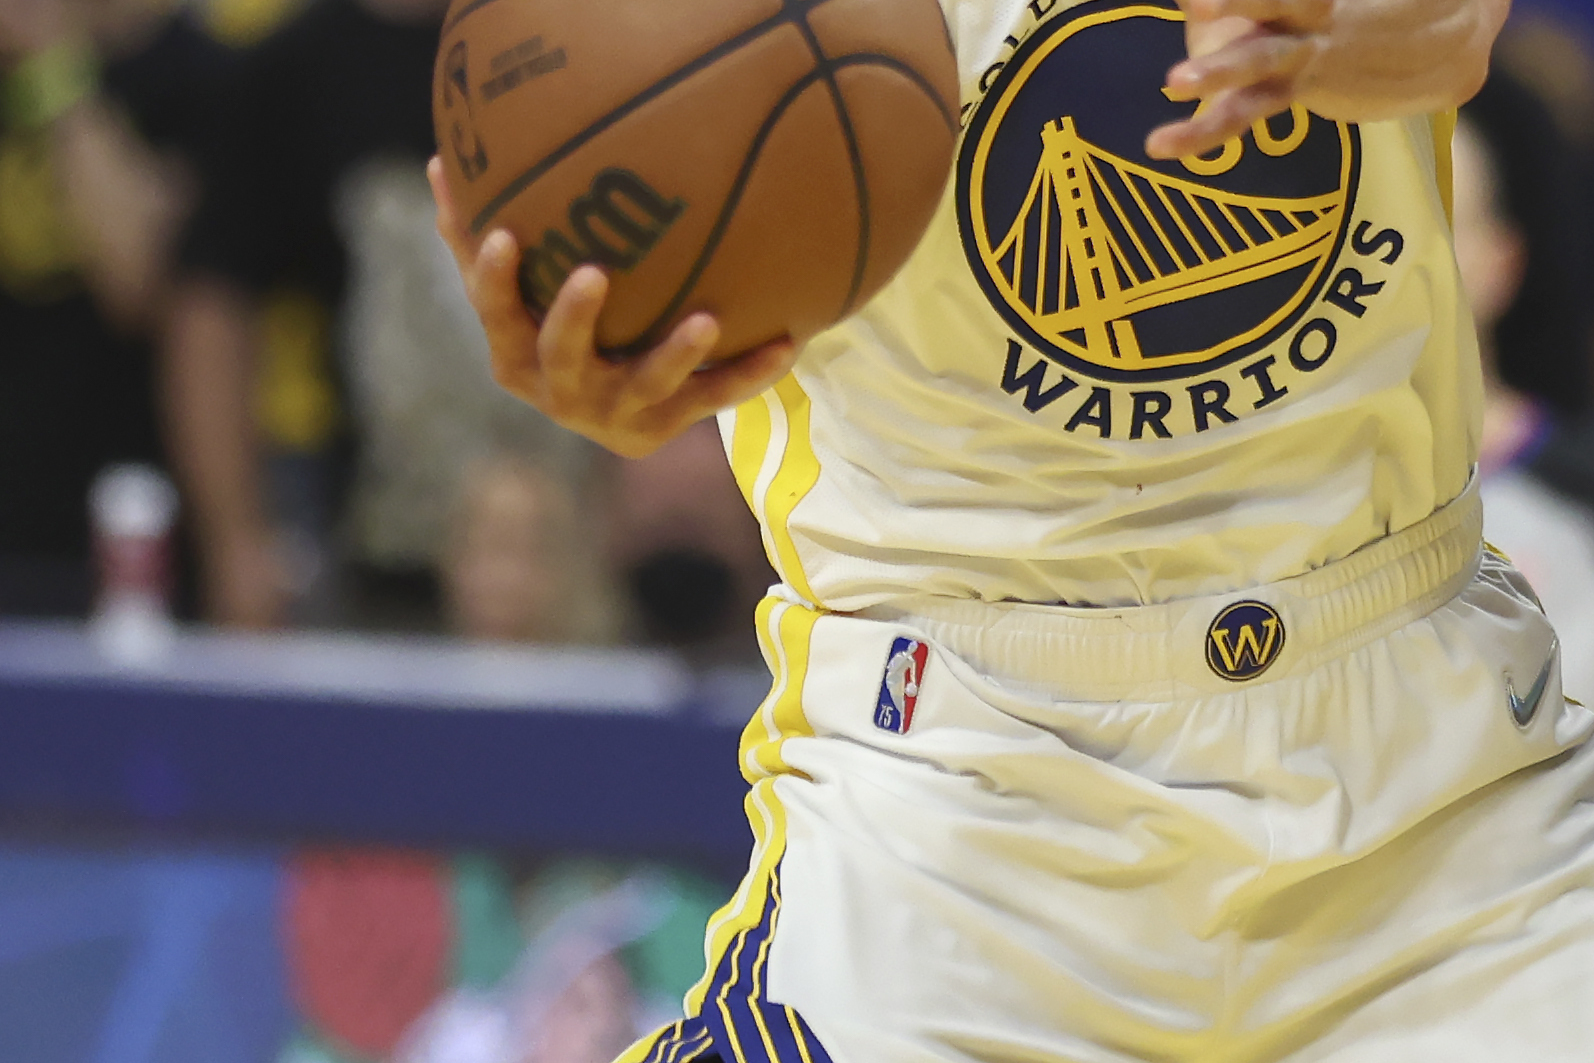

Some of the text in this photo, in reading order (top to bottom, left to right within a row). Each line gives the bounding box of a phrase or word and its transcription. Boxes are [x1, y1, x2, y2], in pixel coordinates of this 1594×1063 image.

[999, 219, 1405, 441] WARRIORS
[1208, 616, 1278, 673] W
[878, 703, 894, 728] 75
